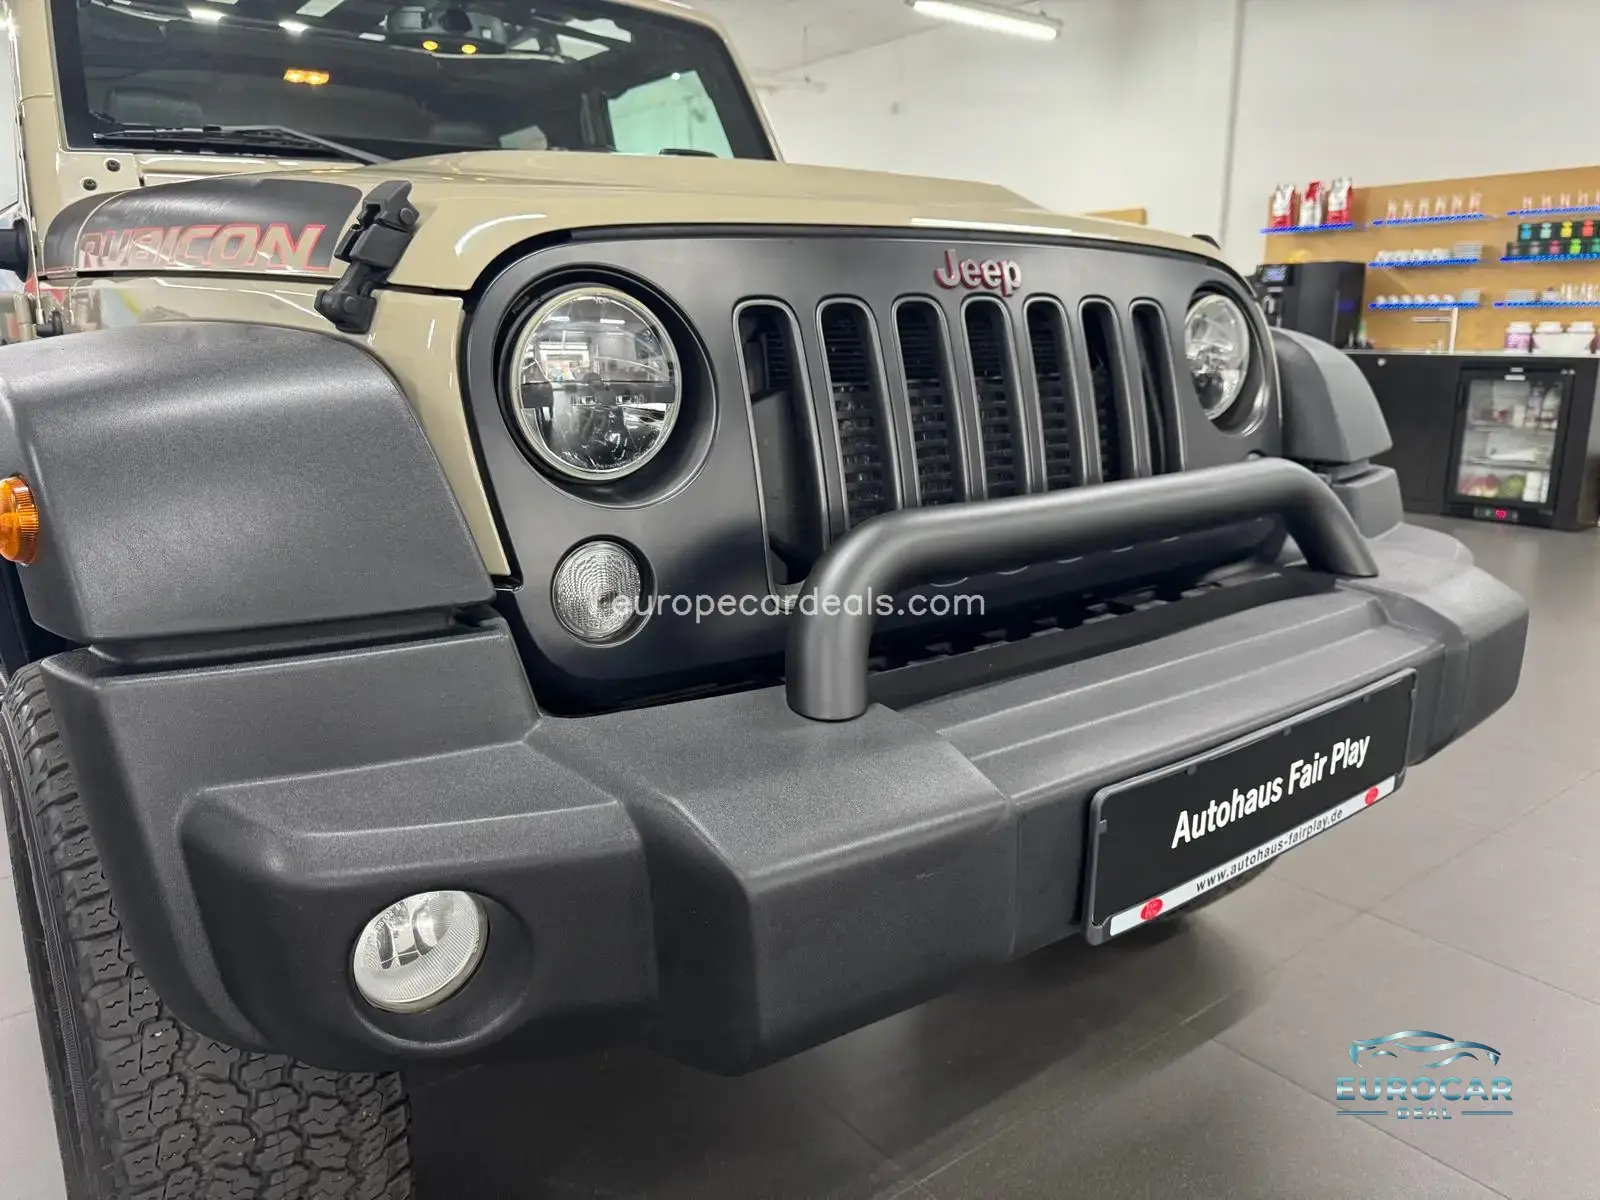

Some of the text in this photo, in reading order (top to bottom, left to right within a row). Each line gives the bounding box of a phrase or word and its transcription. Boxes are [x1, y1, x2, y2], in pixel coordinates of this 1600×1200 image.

[79, 223, 329, 271] RUBICON
[934, 249, 1022, 297] Jeep
[1171, 735, 1371, 849] Autohaus Fair Play
[1196, 808, 1343, 893] www.autohaus-fairplay.de
